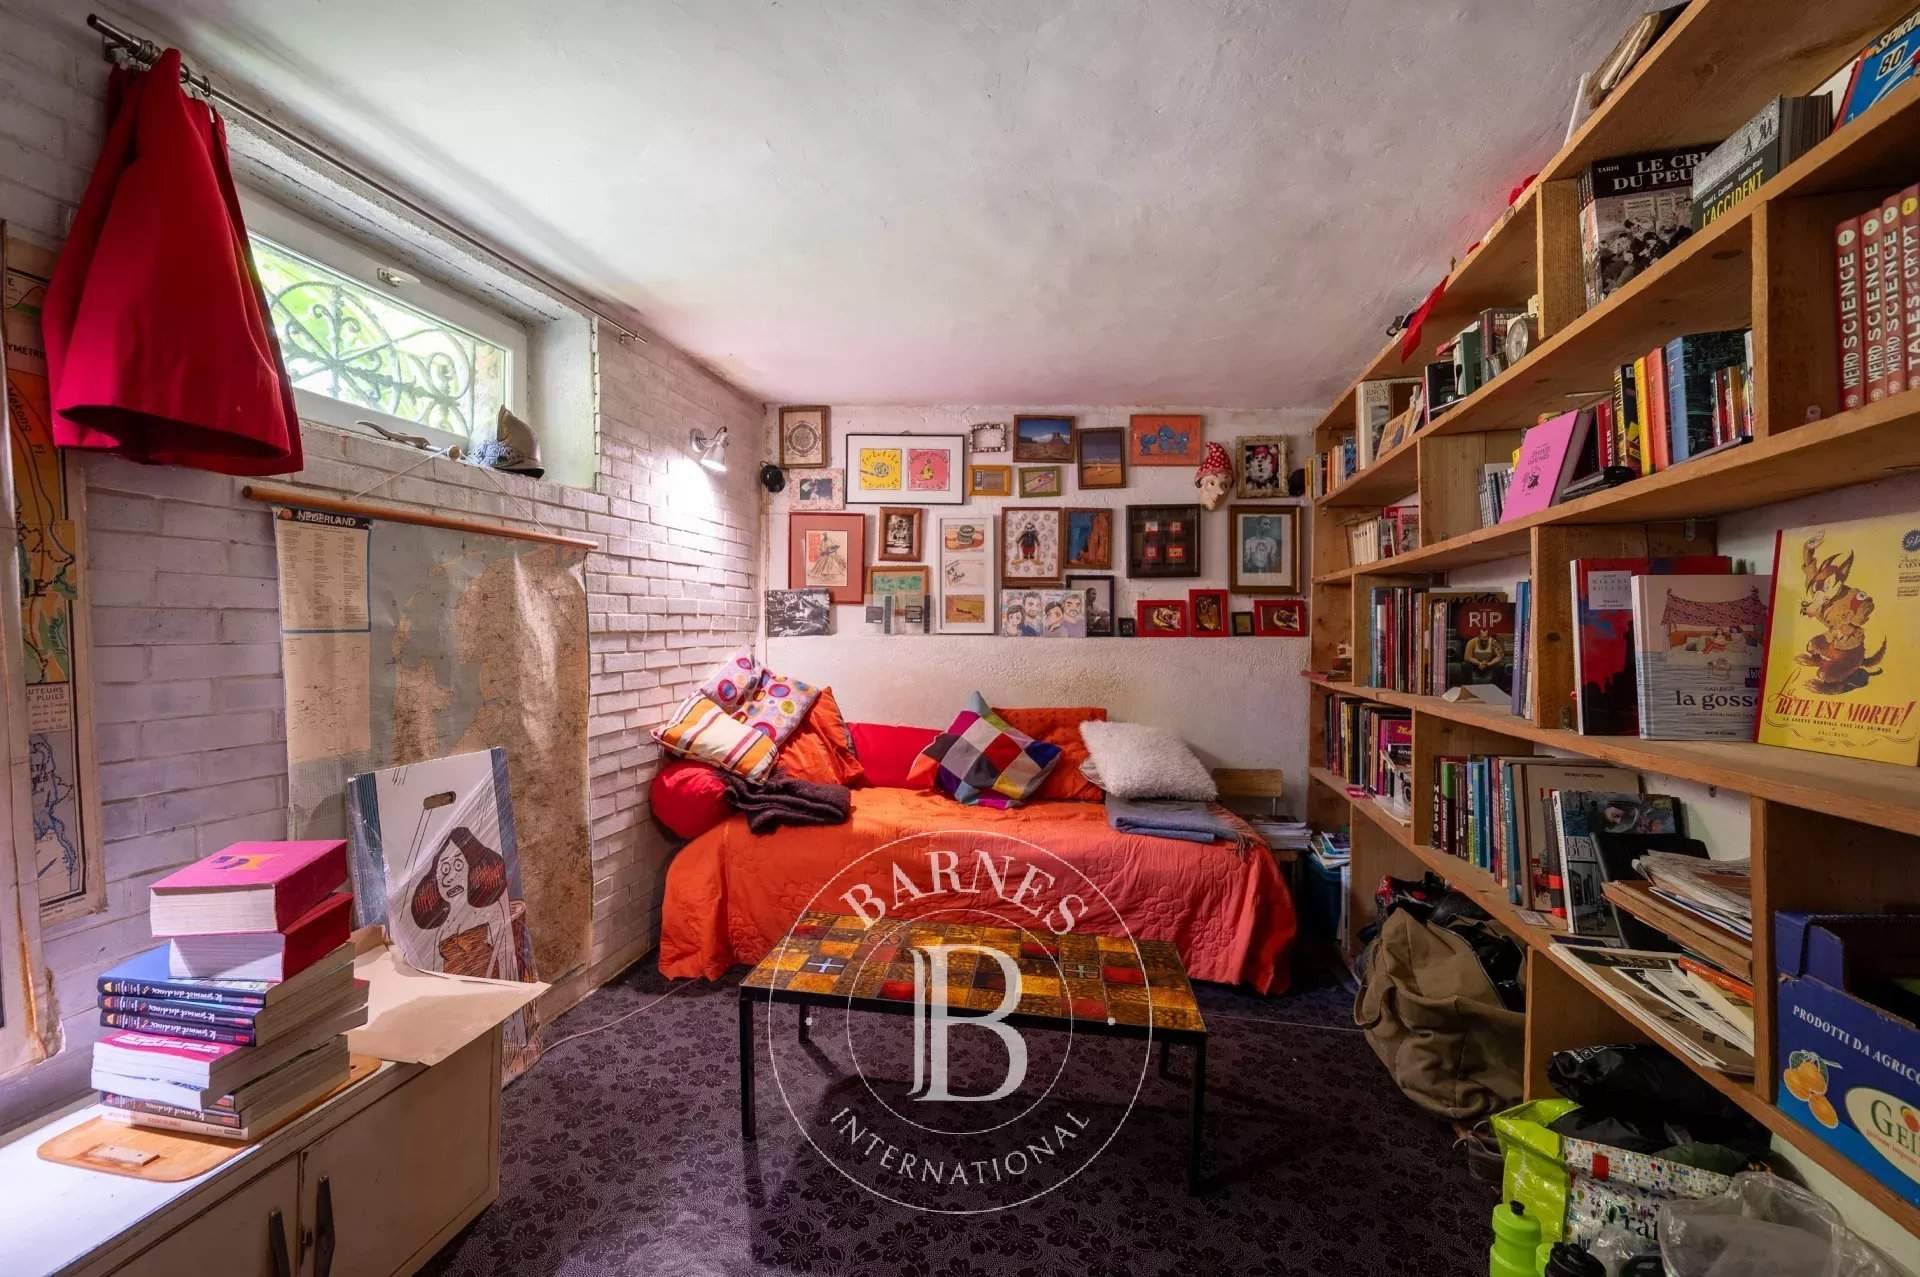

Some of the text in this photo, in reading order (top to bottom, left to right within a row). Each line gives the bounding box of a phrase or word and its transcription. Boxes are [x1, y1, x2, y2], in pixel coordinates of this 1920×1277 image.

[1613, 168, 1693, 191] DU PEU
[1637, 158, 1664, 174] LE
[1903, 224, 1920, 280] CRYPT
[1840, 252, 1860, 389] WEIRD SCIENCE
[1865, 242, 1885, 383] WEIRD SCIENCE
[1884, 230, 1901, 374] WEIRD SCIENCE
[1905, 293, 1920, 371] TALES
[296, 509, 356, 527] NEDERLAND
[1468, 611, 1503, 628] RIP
[1676, 690, 1696, 706] la
[1815, 700, 1845, 720] EST
[1792, 1004, 1850, 1046] PRODOTTI
[1852, 1037, 1870, 1057] DA
